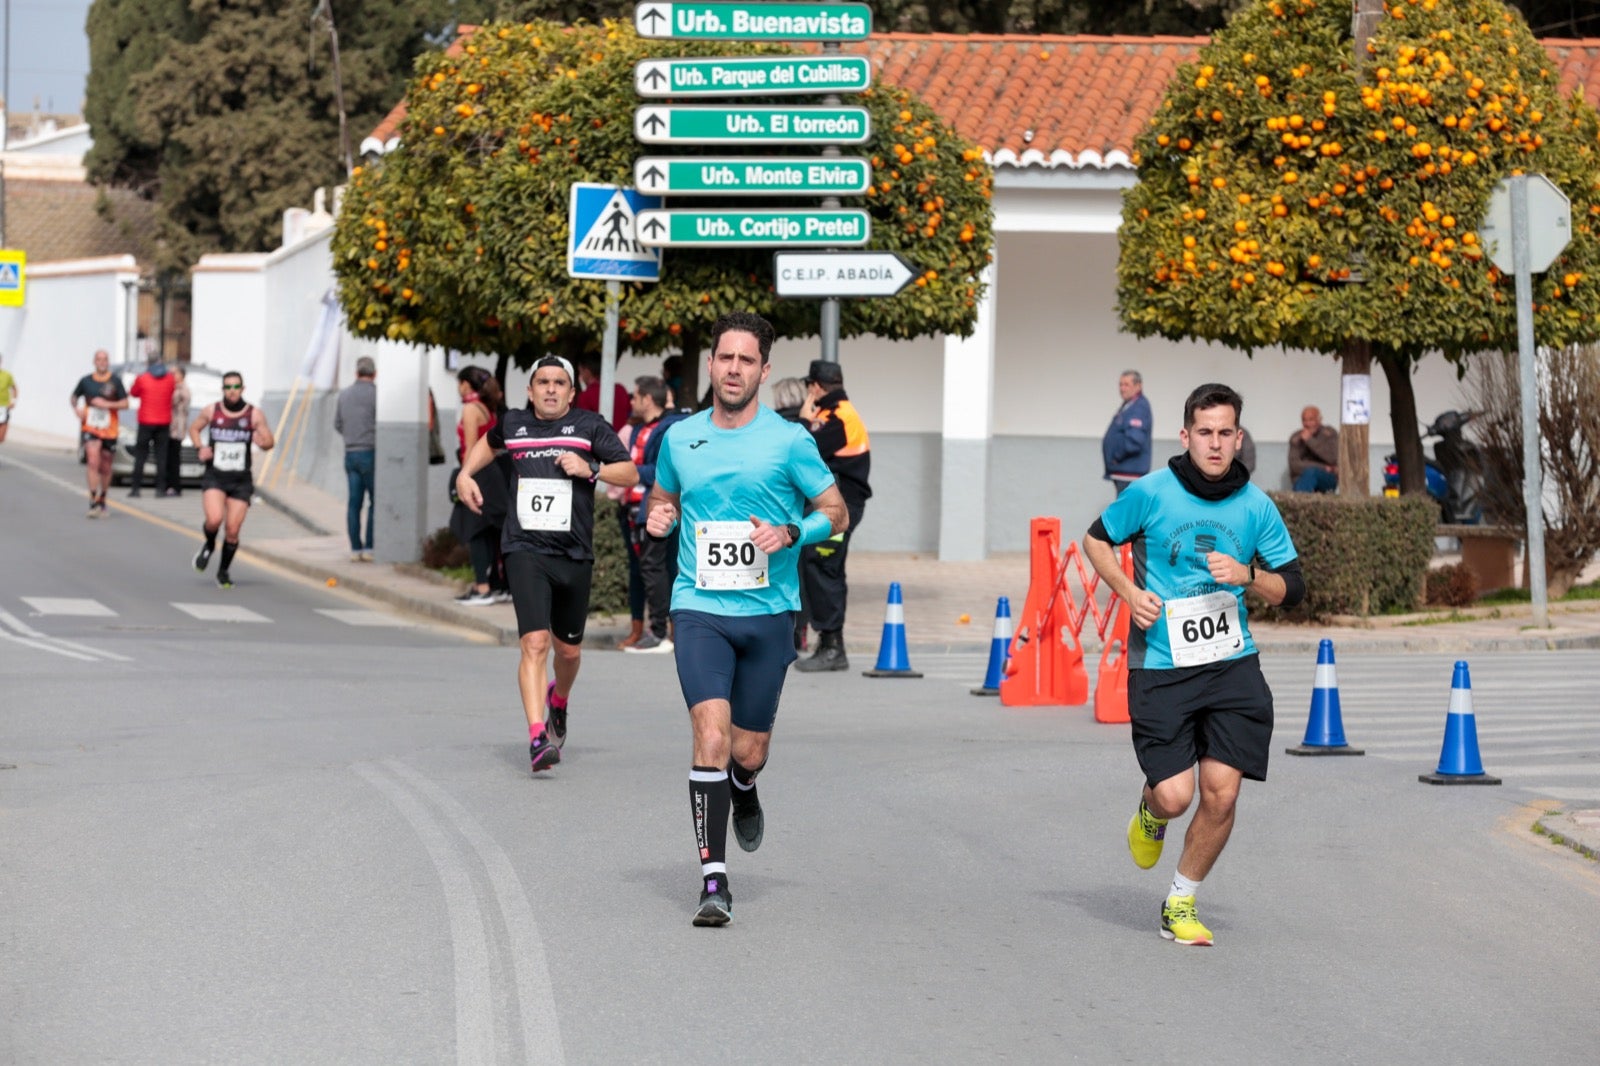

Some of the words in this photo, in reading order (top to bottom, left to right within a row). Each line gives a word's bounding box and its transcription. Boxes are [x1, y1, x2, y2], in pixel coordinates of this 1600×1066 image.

[677, 9, 727, 33] Urb.
[732, 10, 865, 35] Buenavista
[674, 67, 707, 86] Urb.
[711, 66, 766, 88] Parque
[770, 65, 794, 83] del
[798, 64, 860, 83] Cubillas
[726, 115, 765, 133] Urb.
[770, 115, 788, 133] El
[793, 115, 859, 134] torreón
[702, 166, 740, 185] Urb.
[746, 166, 803, 185] Monte
[807, 166, 858, 185] Elvira
[696, 218, 735, 236] Urb.
[740, 217, 799, 240] Cortijo
[805, 217, 859, 236] Pretel
[837, 265, 894, 280] ABADÍA
[531, 494, 555, 513] 67
[707, 542, 756, 567] 530
[1182, 611, 1230, 643] 604
